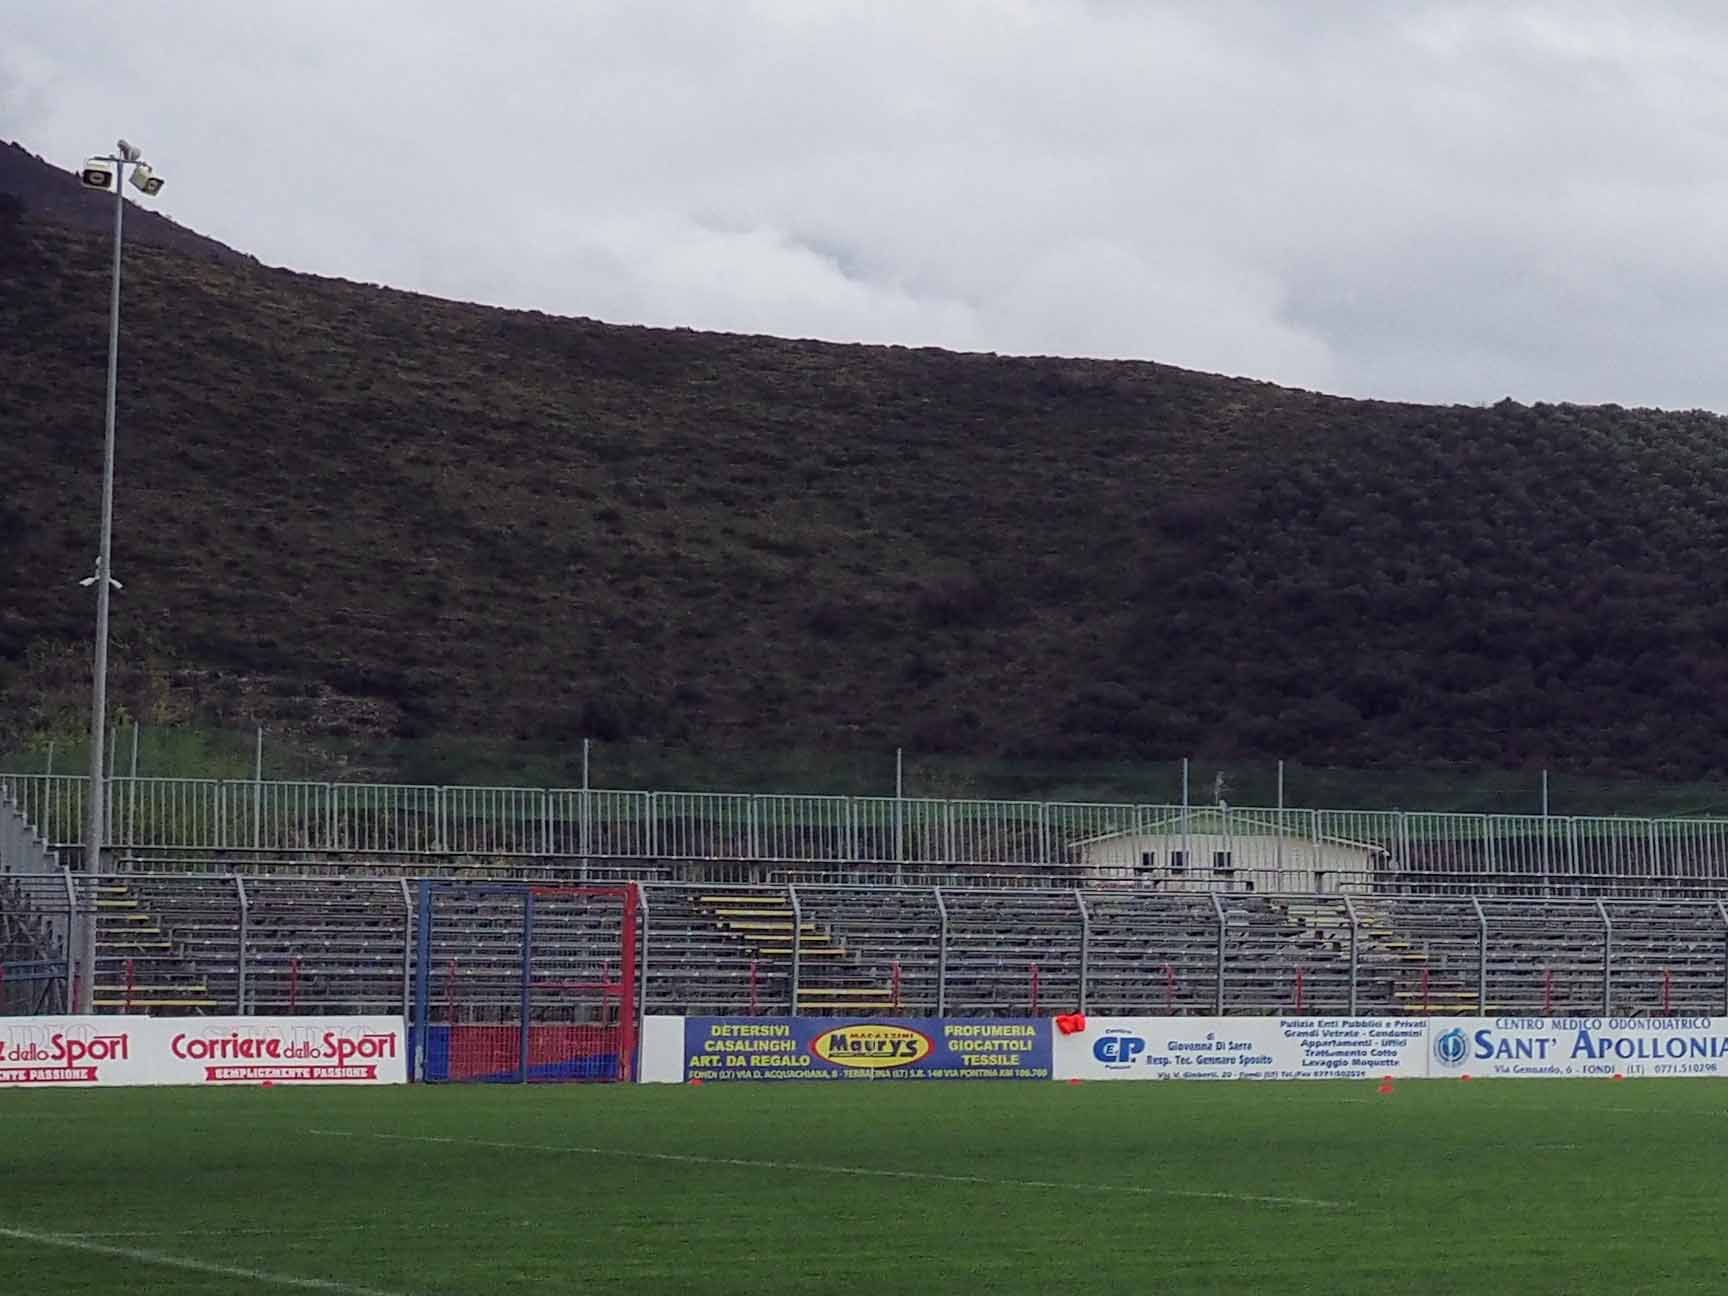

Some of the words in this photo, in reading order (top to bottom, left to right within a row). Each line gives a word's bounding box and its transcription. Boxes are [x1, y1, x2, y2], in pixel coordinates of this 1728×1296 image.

[1394, 1020, 1427, 1028] Privati
[1495, 1018, 1544, 1030] CENTRO
[1552, 1018, 1602, 1030] MEDICO
[1608, 1018, 1711, 1030] ODONTOIATRICO
[712, 1025, 790, 1037] DETERSIVI
[944, 1025, 1036, 1037] PROFUMERIA
[8, 1043, 50, 1062] dello
[51, 1033, 128, 1068] Sport
[171, 1032, 281, 1060] Corriere
[283, 1041, 321, 1059] dello
[322, 1032, 396, 1068] Sport
[704, 1040, 797, 1051] CASALINGHI
[948, 1040, 1033, 1051] GIOCATTOLI
[1216, 1041, 1226, 1050] Di
[690, 1055, 722, 1066] ART.
[726, 1055, 746, 1066] DA
[751, 1055, 811, 1066] REGALO
[961, 1054, 1020, 1065] TESSILE
[1302, 1059, 1348, 1068] Lavaggio
[29, 1068, 88, 1081] PASSIONE
[313, 1067, 368, 1079] PASSIONE
[1583, 1065, 1615, 1074] FONDI
